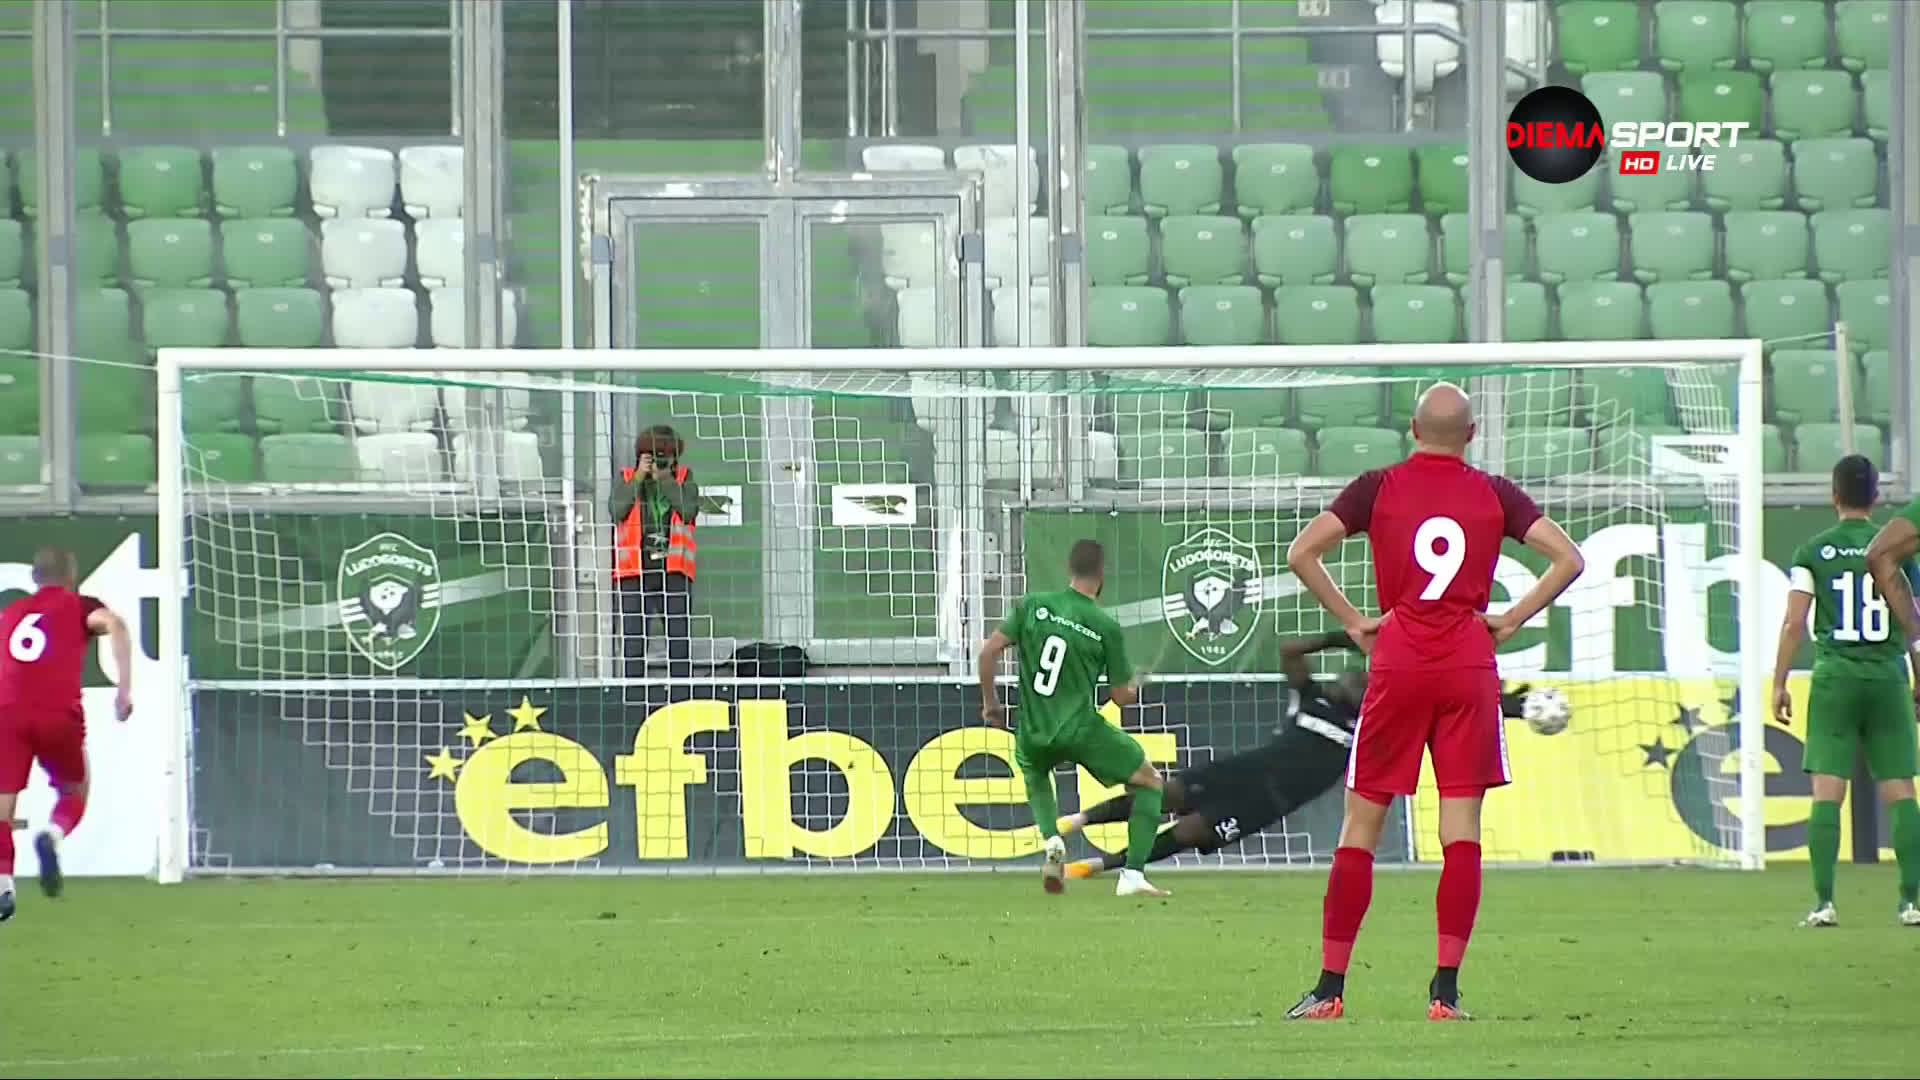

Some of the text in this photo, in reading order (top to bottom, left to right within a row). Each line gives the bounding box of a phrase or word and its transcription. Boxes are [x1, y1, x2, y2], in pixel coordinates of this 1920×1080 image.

[1413, 516, 1466, 600] 9
[9, 612, 47, 663] 6
[1831, 570, 1890, 643] 18
[1033, 634, 1068, 697] 9
